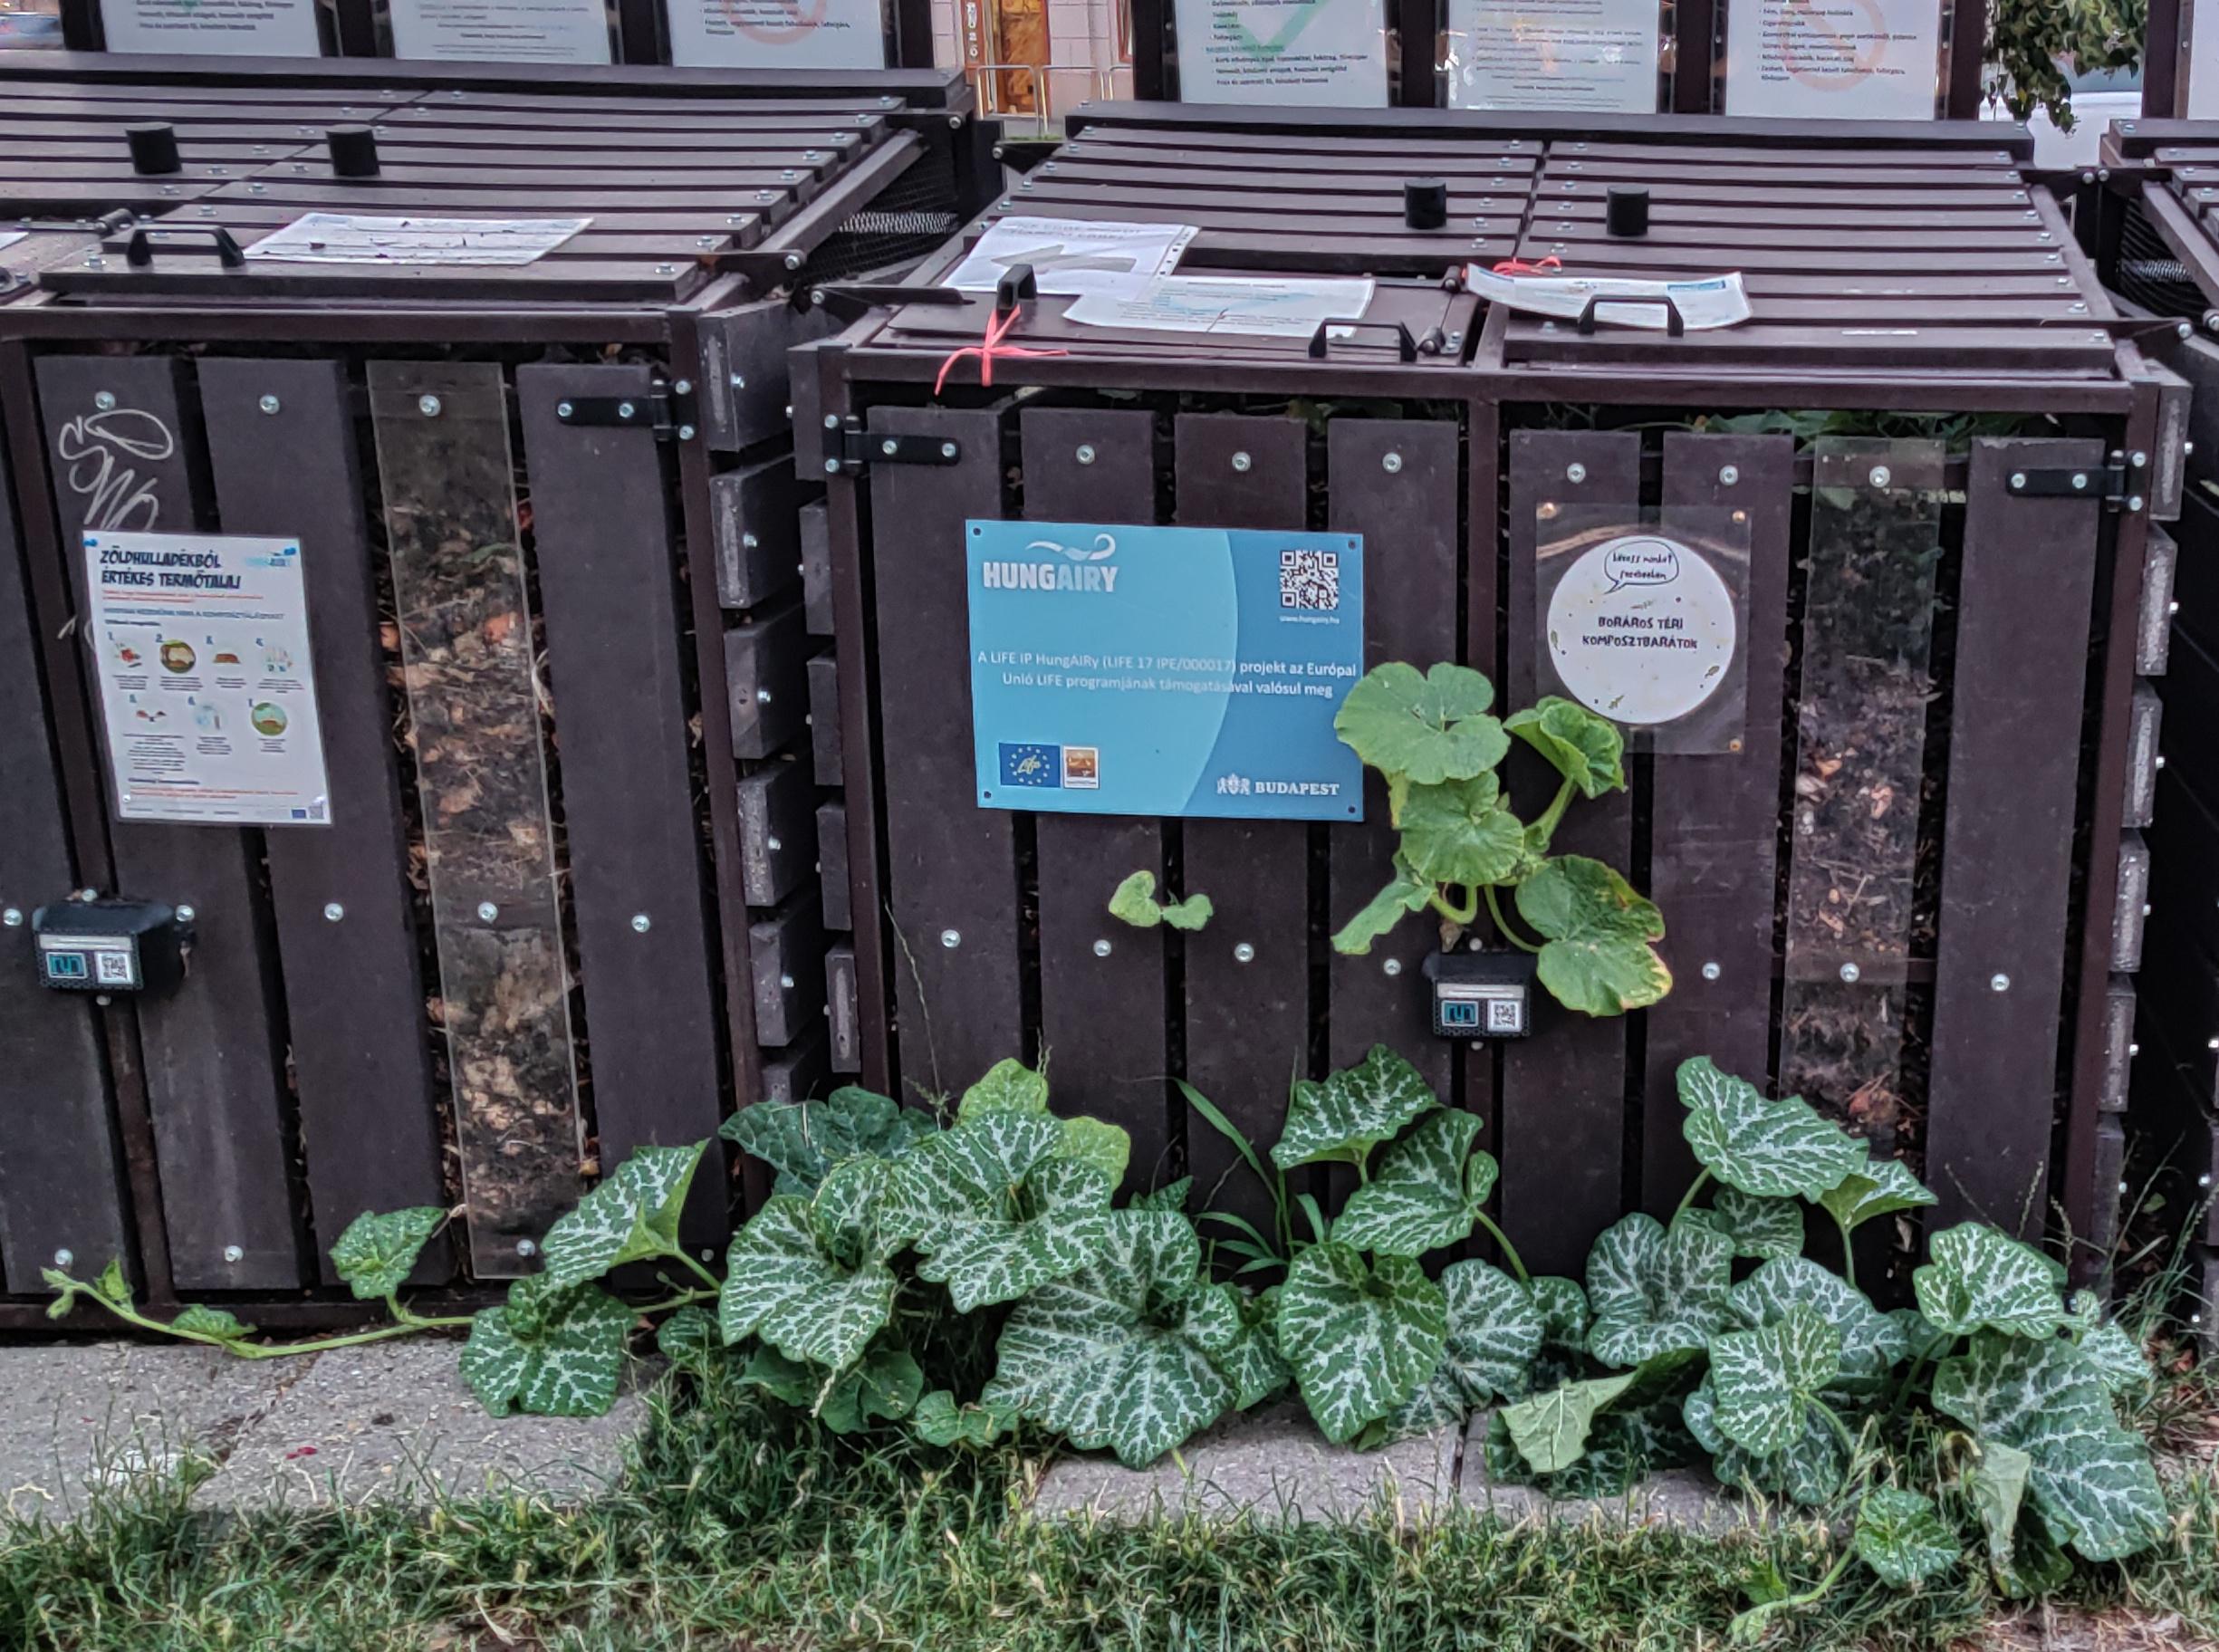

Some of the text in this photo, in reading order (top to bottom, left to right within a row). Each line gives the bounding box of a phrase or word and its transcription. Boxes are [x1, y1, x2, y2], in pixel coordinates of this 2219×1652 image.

[100, 545, 221, 569] ZÖLDHULLADÉKBÓL
[101, 567, 154, 586] ÉRTÉKES
[983, 562, 1119, 593] HUNGAIRY
[1598, 615, 1684, 630] BORÁROS TÉRI
[1582, 634, 1698, 649] KOMPOSZTBARÁTOK
[978, 651, 987, 664] A
[991, 651, 1015, 665] LIFE
[1020, 652, 1033, 666] IP
[1036, 654, 1100, 669] HungAIRy
[1102, 656, 1133, 669] (LIFE
[1138, 657, 1152, 669] 17
[1158, 657, 1236, 674] IPE/000017)
[1240, 660, 1286, 676] projekt
[1289, 663, 1304, 676] az
[1003, 672, 1333, 698] Unió LIFE programjának támogatásával valósul meg
[1254, 781, 1340, 796] BUDAPEST
